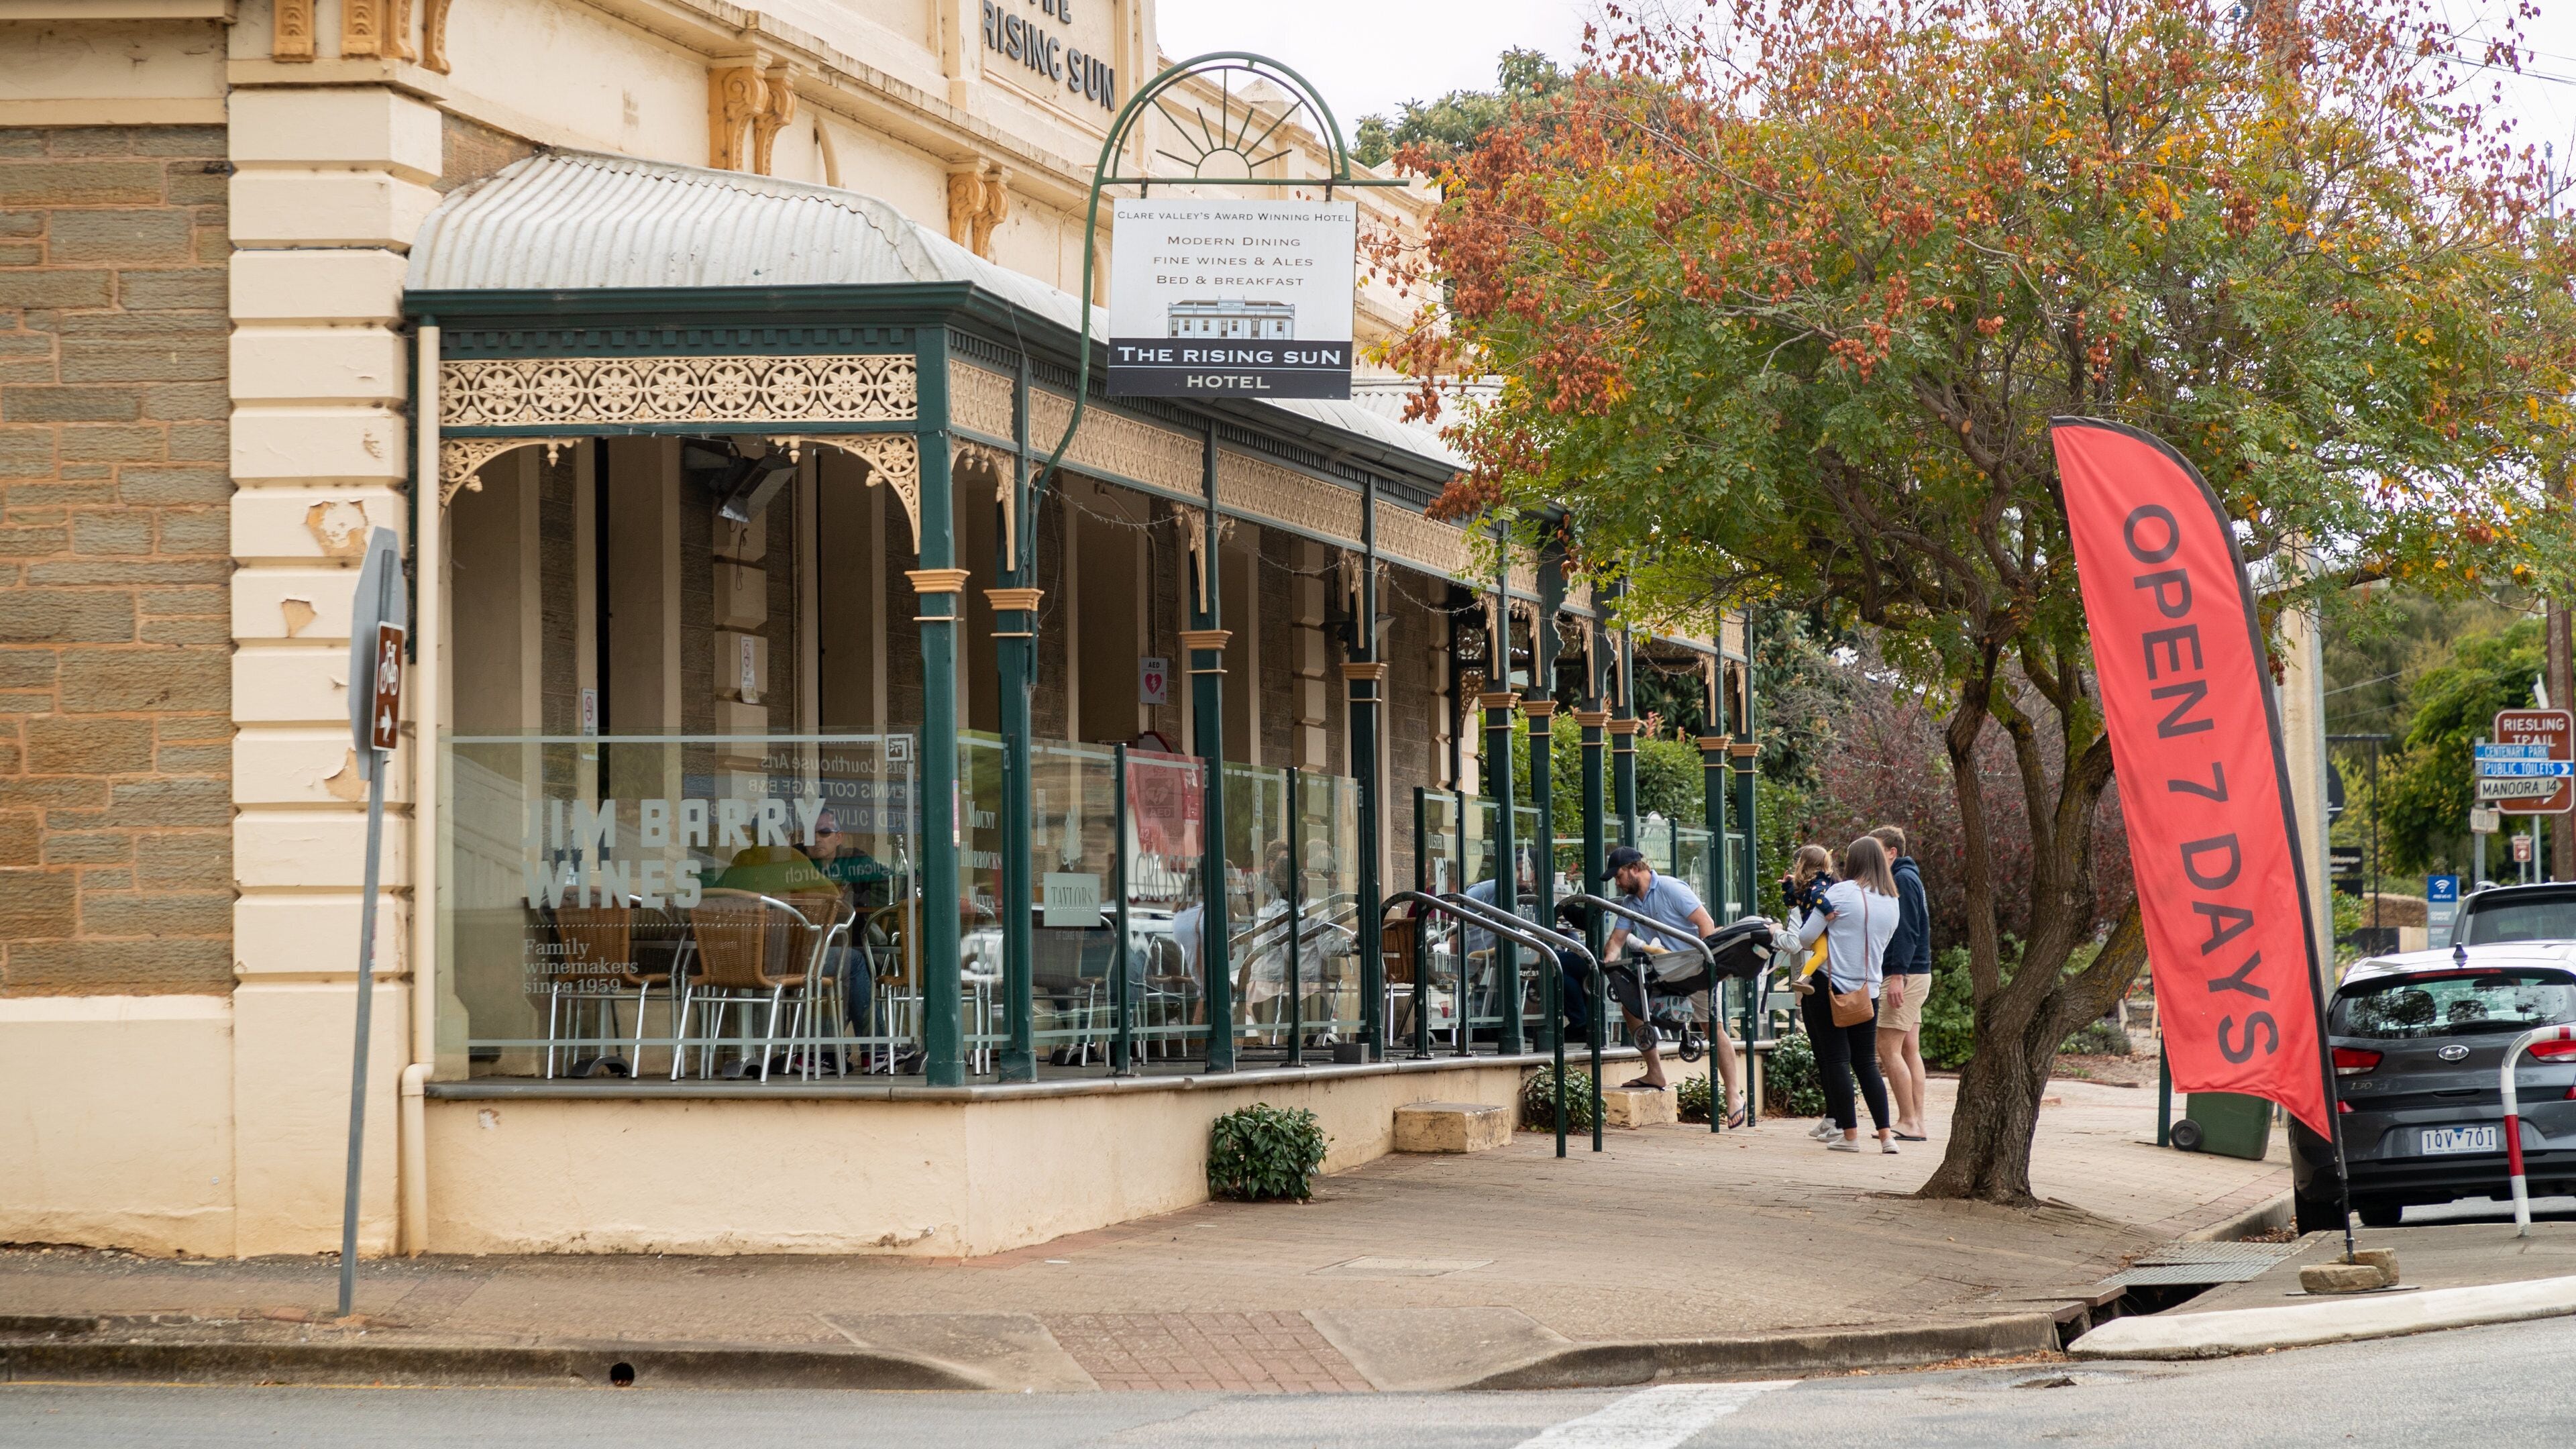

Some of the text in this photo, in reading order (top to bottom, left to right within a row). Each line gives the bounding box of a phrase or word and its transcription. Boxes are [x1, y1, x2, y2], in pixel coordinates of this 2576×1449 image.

[983, 0, 1115, 111] RISING SUN
[1118, 211, 1351, 222] CLARE VALLEY'S AWARD WINNING HOTEL
[1168, 236, 1301, 247] MODERN DINING
[1153, 256, 1313, 266] FINE WINES & ALES
[1157, 275, 1304, 286] BED & BREAKFAST
[1118, 346, 1340, 365] THE RISING SUN
[1187, 375, 1271, 389] HOTEL
[2503, 717, 2565, 732] RIESLING
[2484, 745, 2548, 757] CENTENARY PARK
[2485, 762, 2555, 775] PUBLIC TOILETS
[2123, 504, 2279, 1065] OPEN 7 DAYS
[2482, 780, 2557, 796] MANOORA 14
[966, 800, 996, 829] MOUNT
[1148, 809, 1171, 818] AED
[521, 798, 826, 848] JIM BARRY
[961, 841, 1003, 870] HORROCKS
[522, 859, 702, 909] WINES
[1136, 852, 1201, 902] GROSSET
[1051, 885, 1093, 906] TAYLORS
[524, 938, 590, 959] Family
[523, 958, 639, 974] winemakers
[523, 977, 621, 995] since 1959
